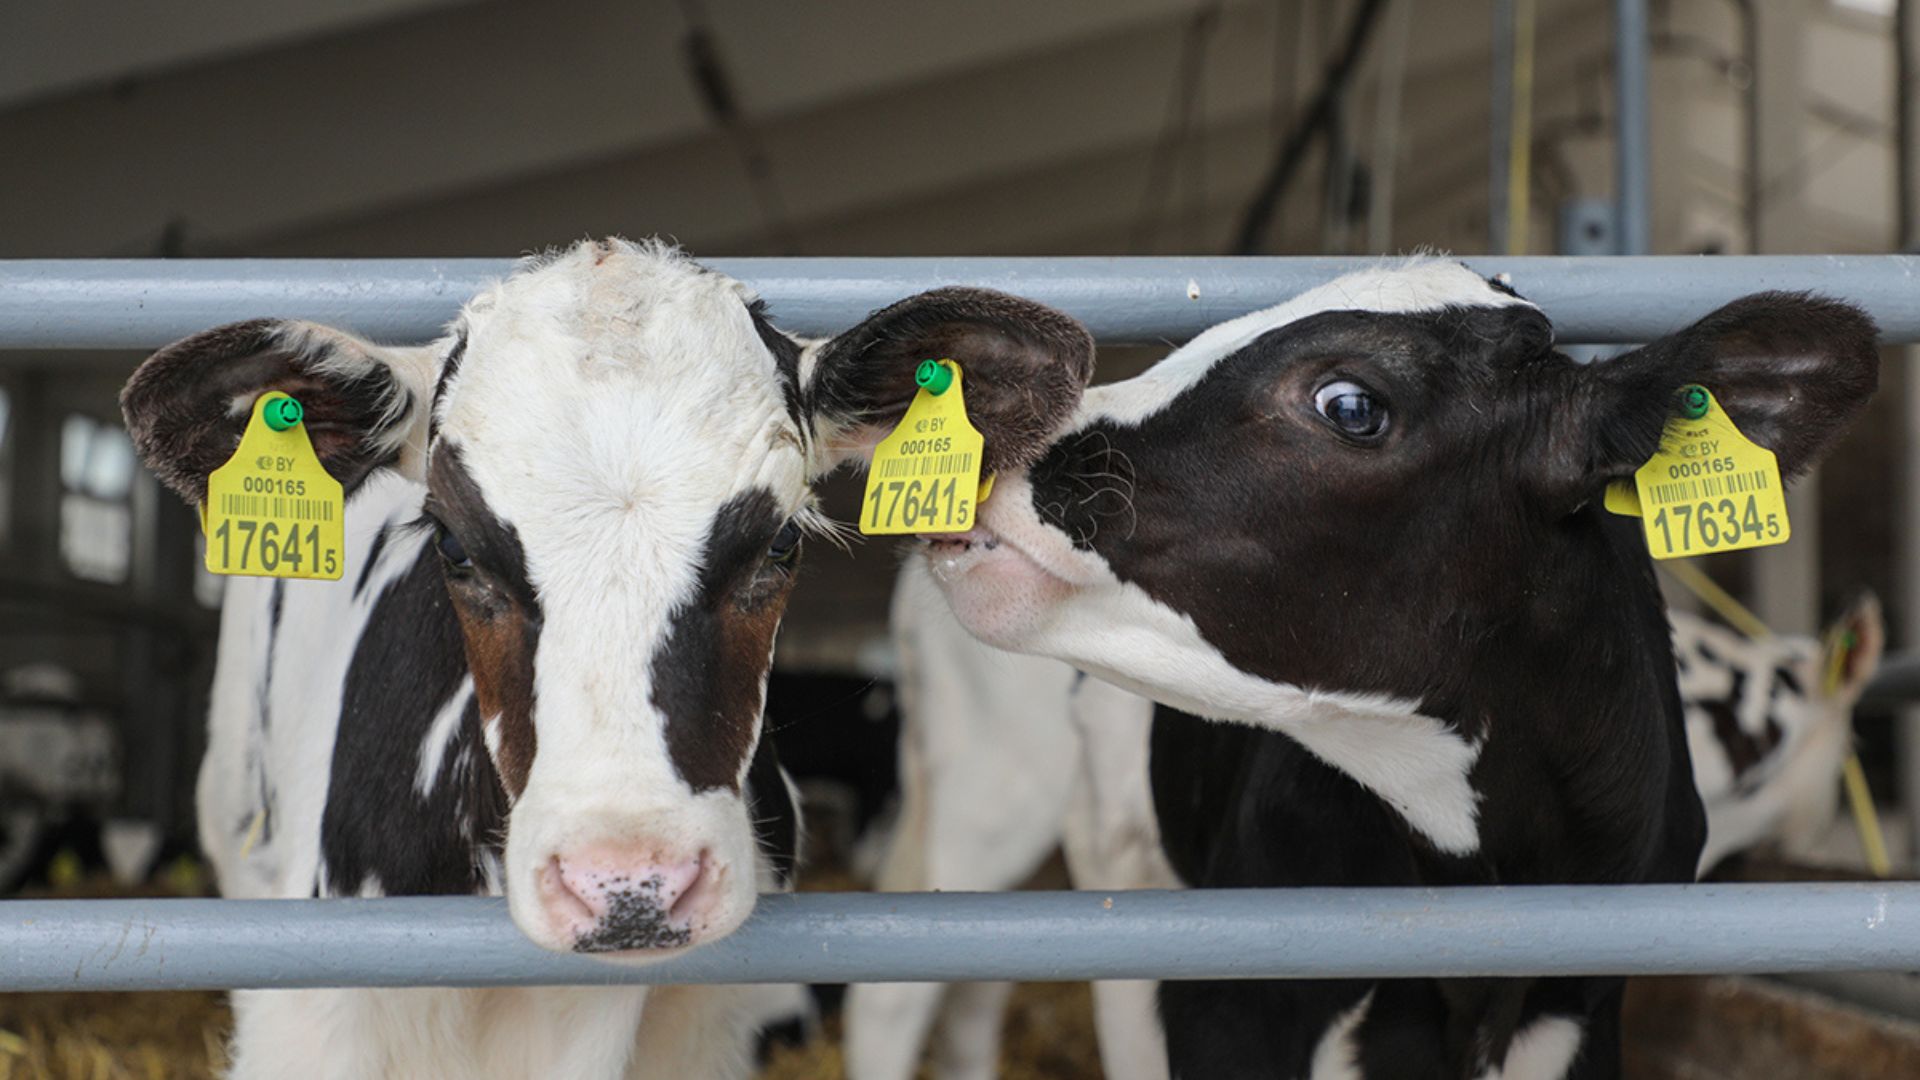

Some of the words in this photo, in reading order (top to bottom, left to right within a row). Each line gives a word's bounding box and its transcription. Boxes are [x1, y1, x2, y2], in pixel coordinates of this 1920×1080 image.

[900, 437, 951, 455] 000165
[276, 456, 296, 472] BY
[1669, 456, 1735, 479] 000165
[243, 476, 306, 496] 000165
